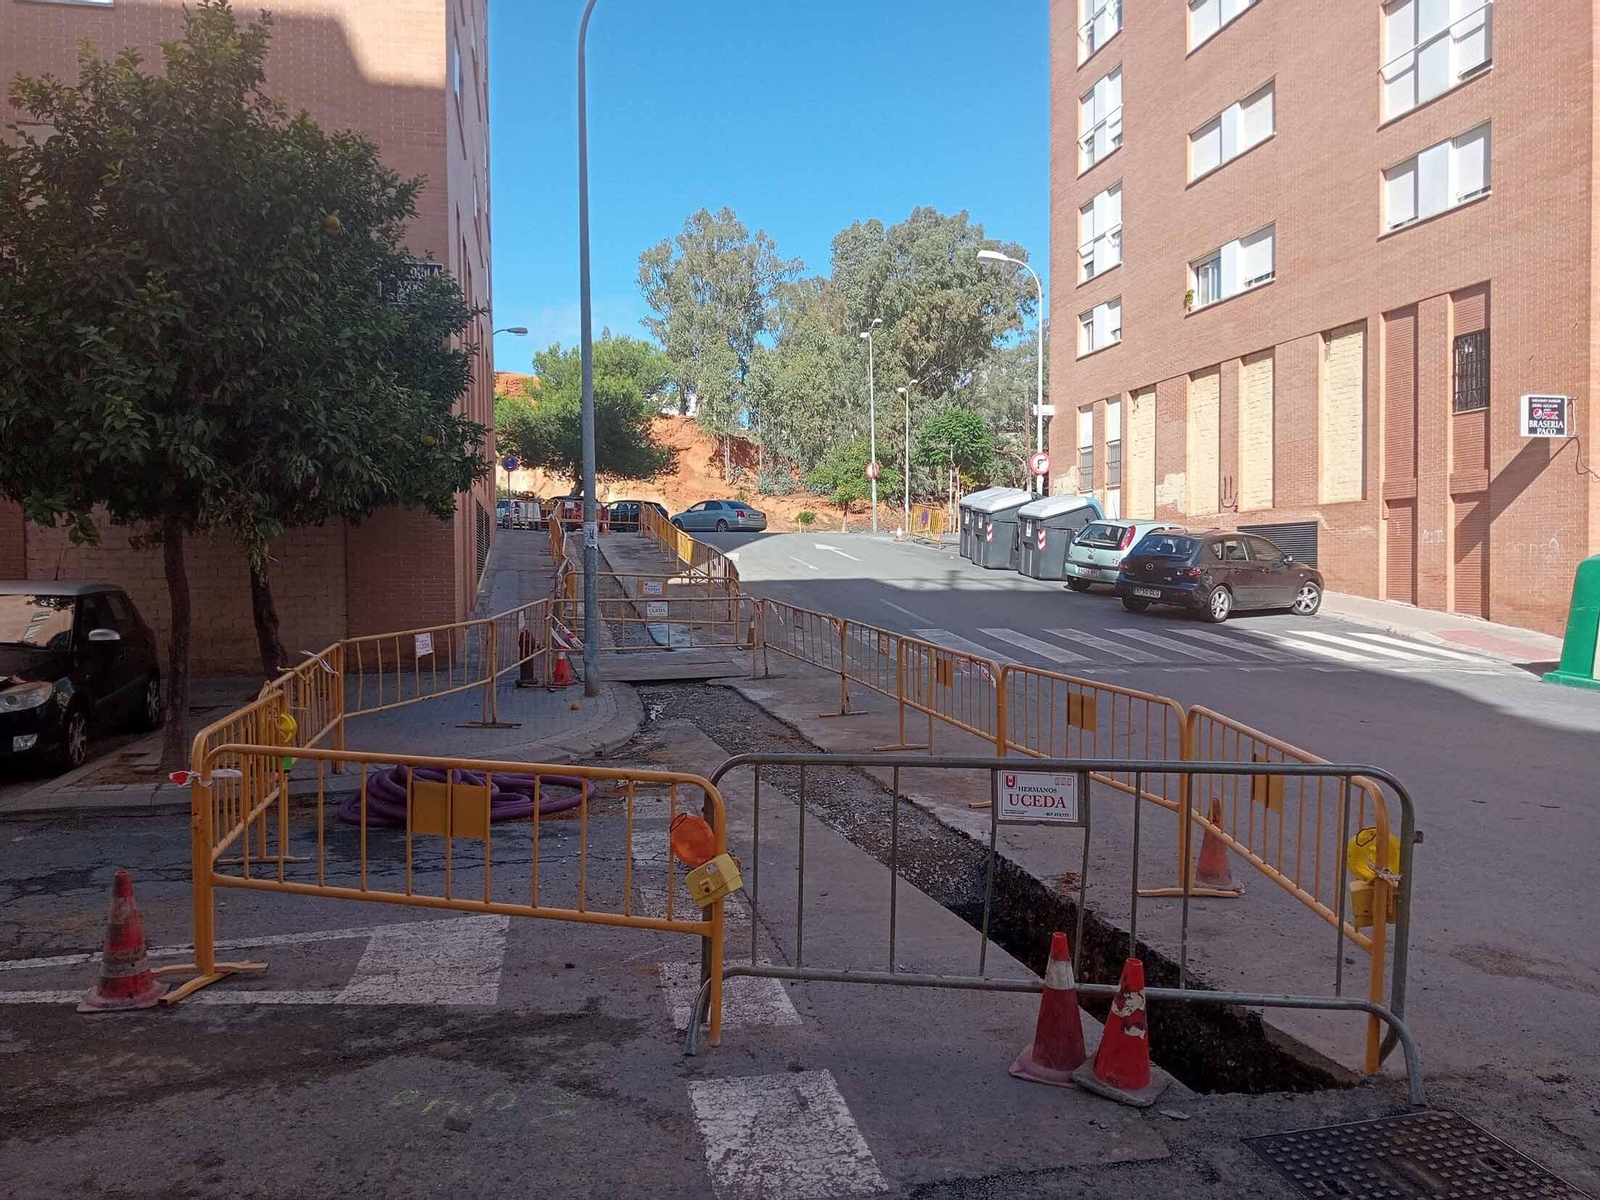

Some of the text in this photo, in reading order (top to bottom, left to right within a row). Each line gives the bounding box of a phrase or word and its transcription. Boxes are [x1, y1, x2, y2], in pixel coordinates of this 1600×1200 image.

[1529, 420, 1564, 428] BRASERIA
[1018, 786, 1058, 794] HERMANOS
[1009, 793, 1067, 809] UCEDA
